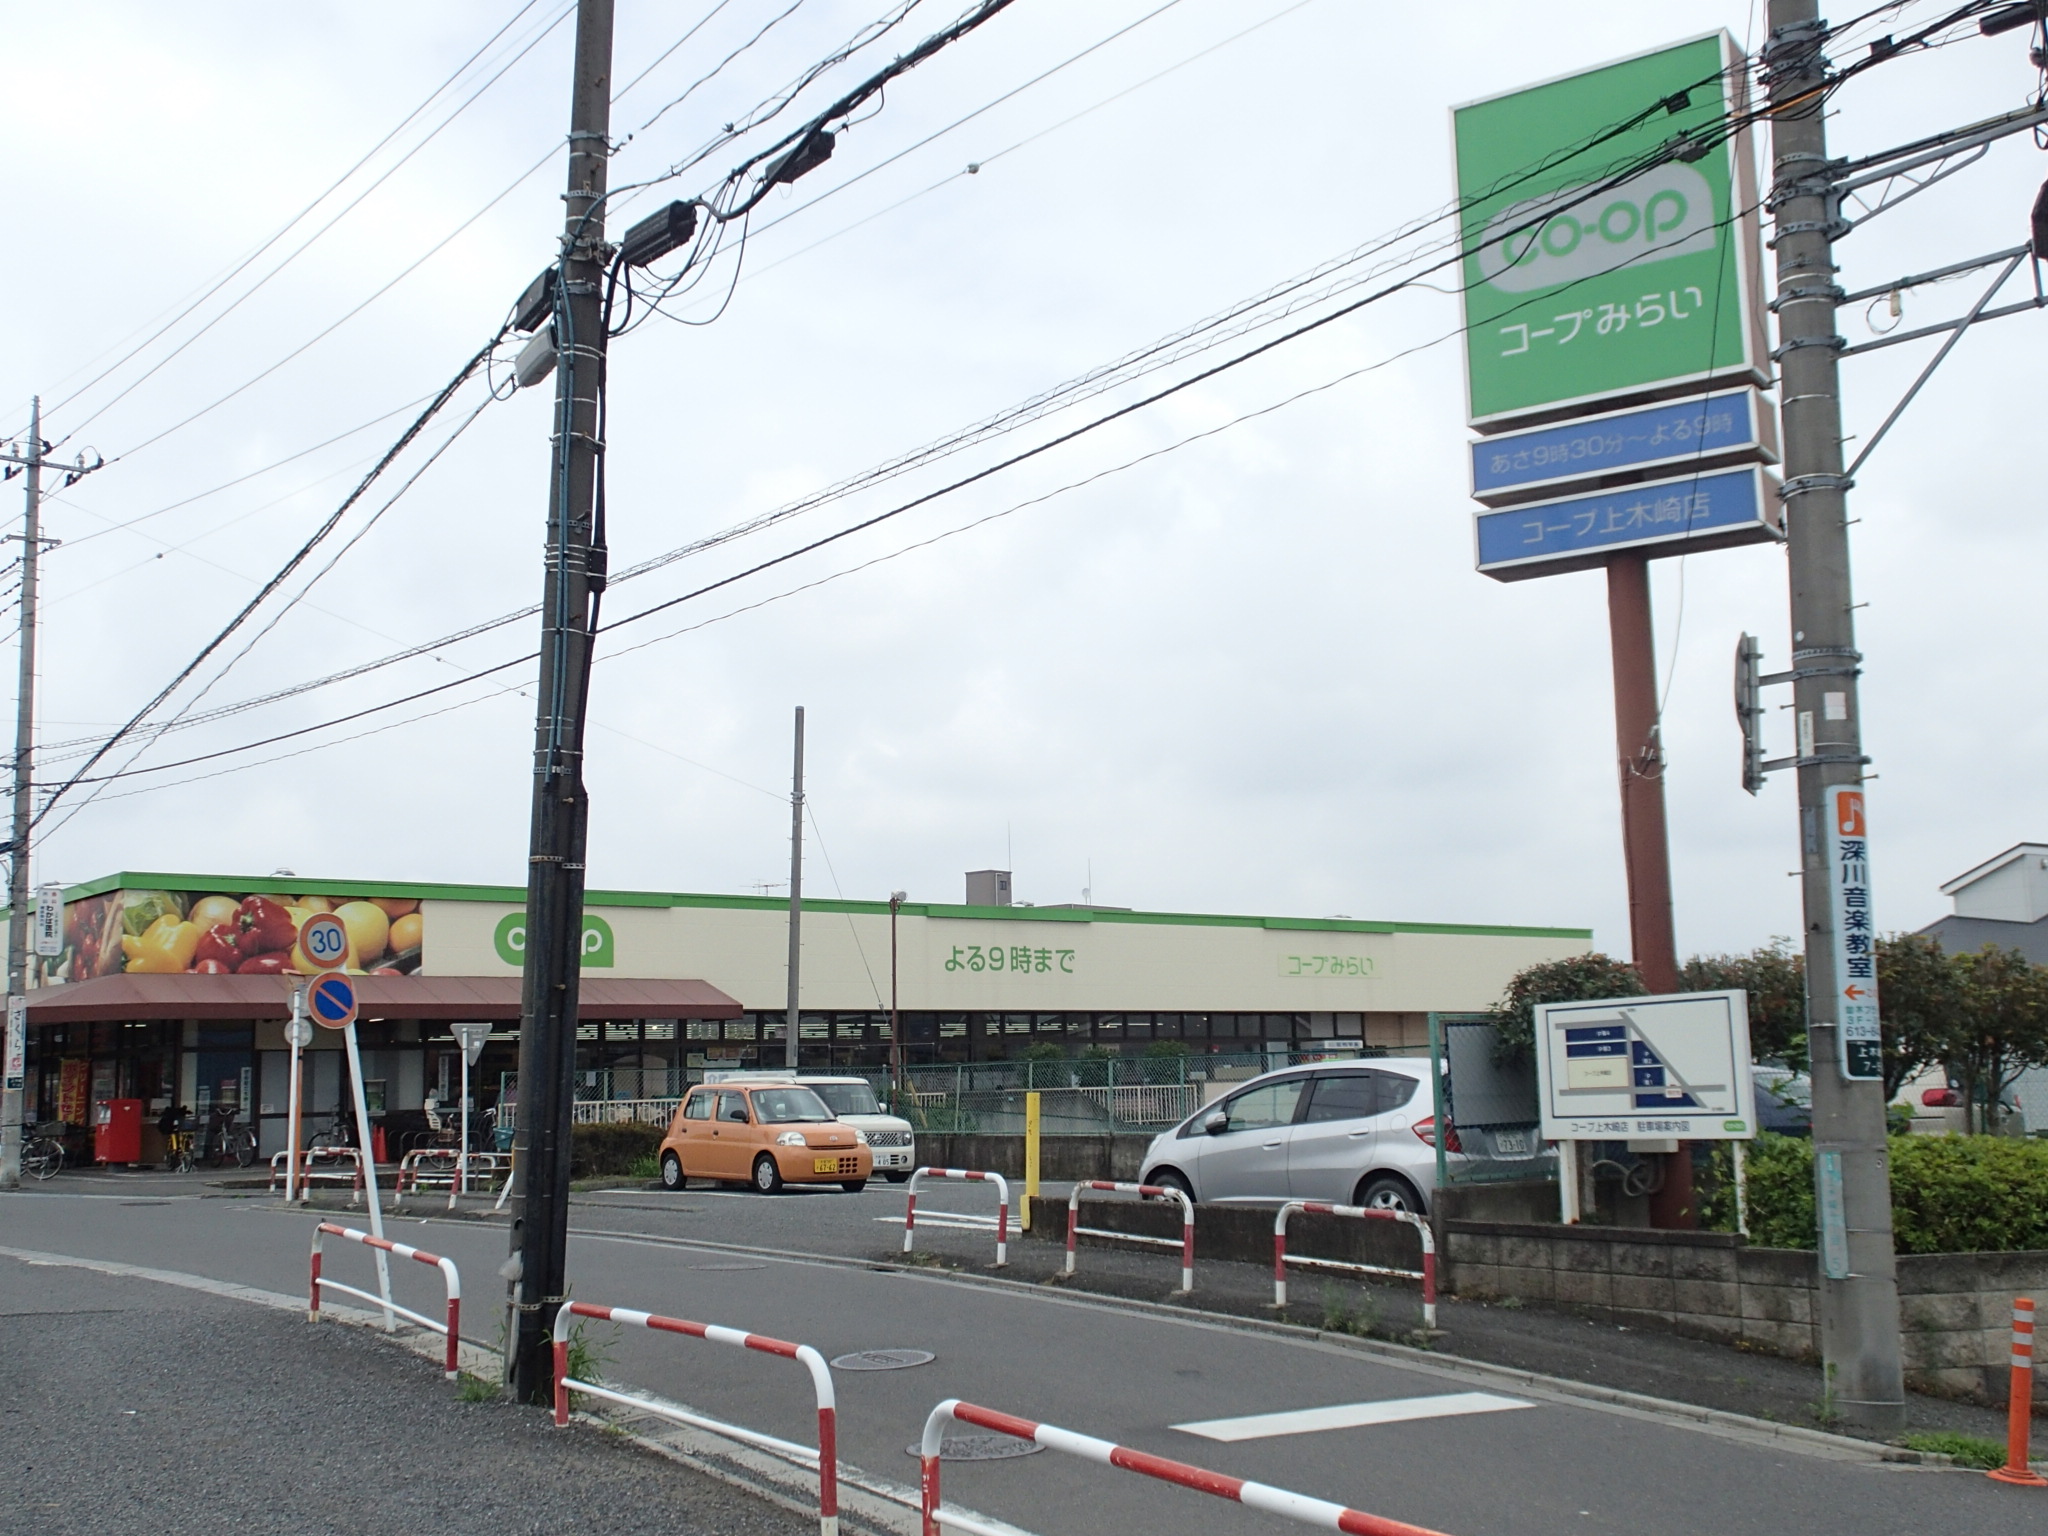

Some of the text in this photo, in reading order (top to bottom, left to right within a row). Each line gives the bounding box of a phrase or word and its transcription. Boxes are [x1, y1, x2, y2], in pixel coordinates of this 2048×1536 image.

[1499, 286, 1704, 357] コープみらい
[1522, 492, 1712, 545] コープ上木崎店
[1840, 840, 1873, 978] 深川音楽教室
[311, 928, 342, 954] 30
[944, 945, 1076, 975] よる9時まで
[1288, 956, 1374, 976] コープみらい
